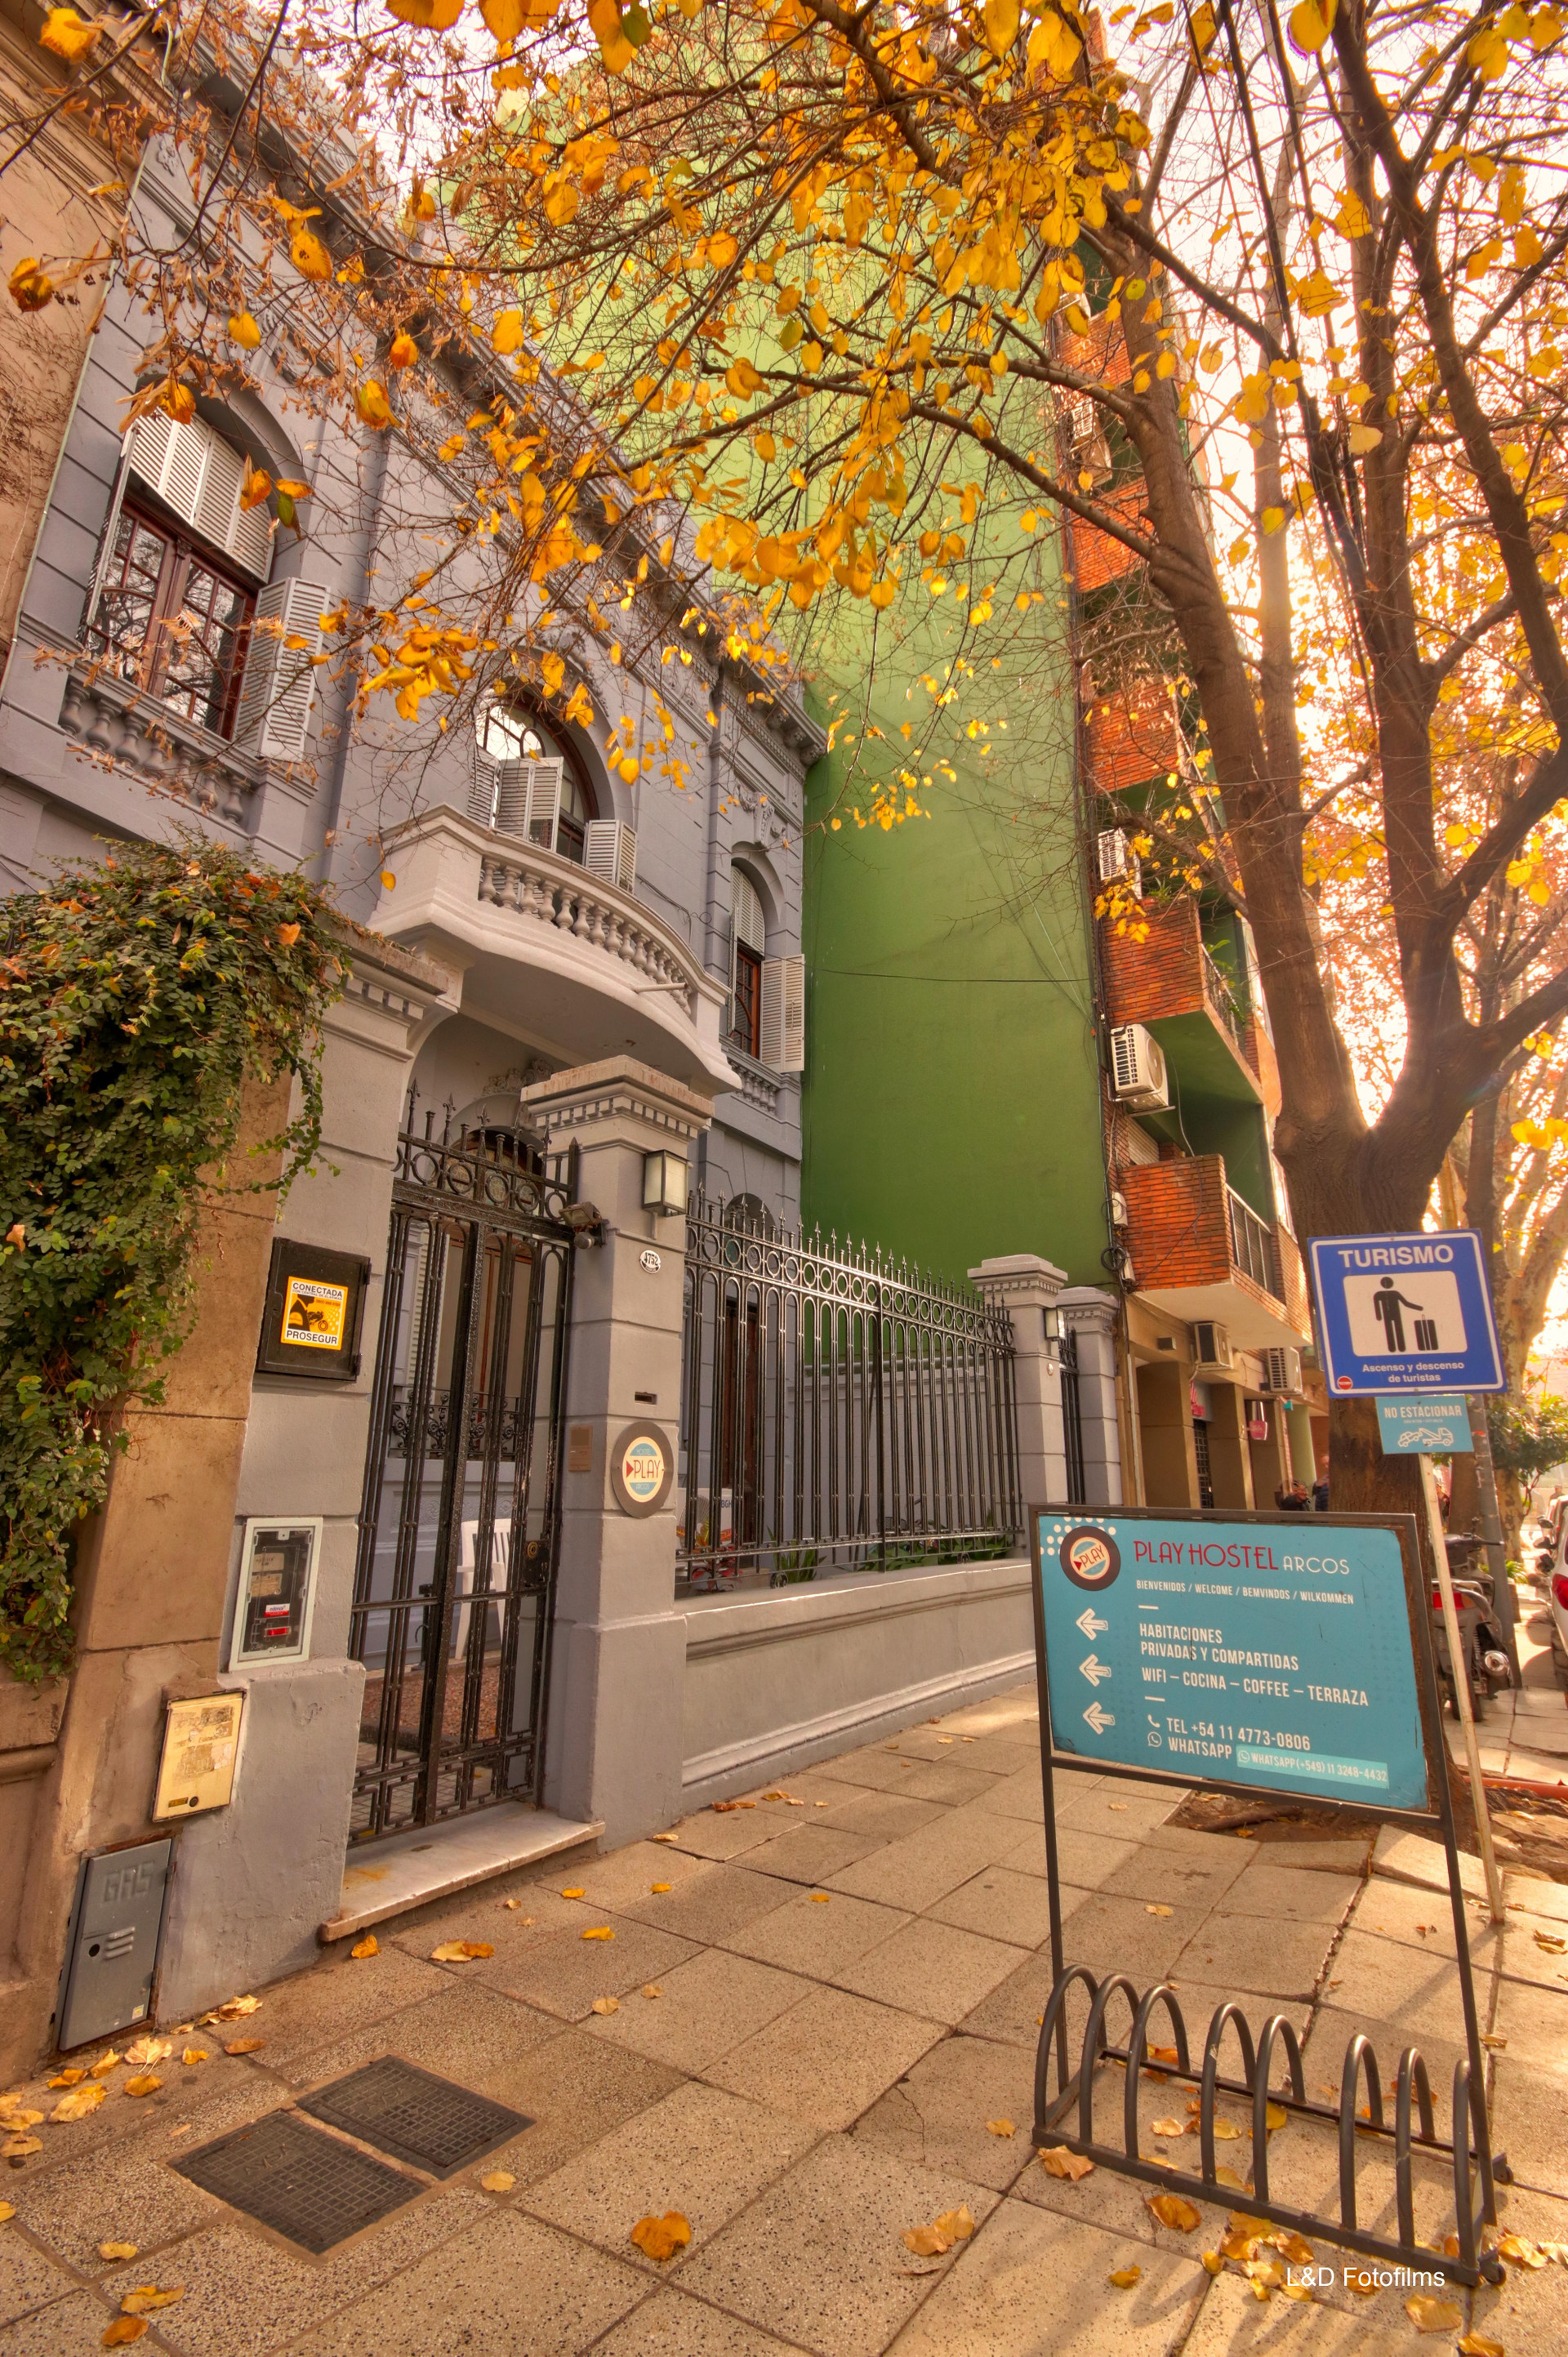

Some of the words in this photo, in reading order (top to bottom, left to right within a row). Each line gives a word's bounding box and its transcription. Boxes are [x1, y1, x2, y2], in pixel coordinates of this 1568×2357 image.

[1338, 1245, 1454, 1268] TURISMO
[292, 1282, 342, 1298] CONECTADA
[286, 1330, 337, 1344] PROSEGUR
[1362, 1364, 1405, 1372] Ascenso
[1408, 1365, 1414, 1373] y
[1416, 1362, 1464, 1371] descenso
[1388, 1374, 1401, 1383] de
[1402, 1373, 1441, 1382] turistas
[1384, 1407, 1397, 1419] NO
[1401, 1405, 1462, 1418] ESTACIONAR
[634, 1459, 661, 1478] PLAY
[1079, 1544, 1105, 1568] PLAY
[1134, 1540, 1183, 1565] PLAY
[1188, 1543, 1279, 1571] HOSTEL
[1283, 1555, 1350, 1575] ARCOS
[1136, 1580, 1186, 1593] BIENVENIDOS
[1195, 1584, 1233, 1596] WELCOME
[1242, 1587, 1290, 1600] BEMVINDOS
[1299, 1591, 1354, 1605] WILKOMMEN
[1139, 1623, 1223, 1644] HABITACIONES
[1140, 1641, 1197, 1660] PRIVADAS
[1200, 1646, 1208, 1661] Y
[1212, 1649, 1299, 1671] COMPARTIDAS
[1142, 1667, 1167, 1683] WIFI
[1183, 1671, 1227, 1690] COCINA
[1243, 1678, 1290, 1698] COFFEE
[1307, 1685, 1369, 1707] TERRAZA
[1166, 1717, 1188, 1735] TEL
[1191, 1722, 1214, 1738] +54
[1219, 1725, 1233, 1740] 11
[1237, 1727, 1311, 1751] 4773-0806
[1168, 1736, 1232, 1759] WHATSAPP
[1250, 1752, 1295, 1768] WHATSAPP
[1296, 1758, 1325, 1773] (+549)
[1327, 1763, 1334, 1774] 11
[1338, 1765, 1388, 1782] 3248-4432
[103, 1860, 155, 1905] GAS
